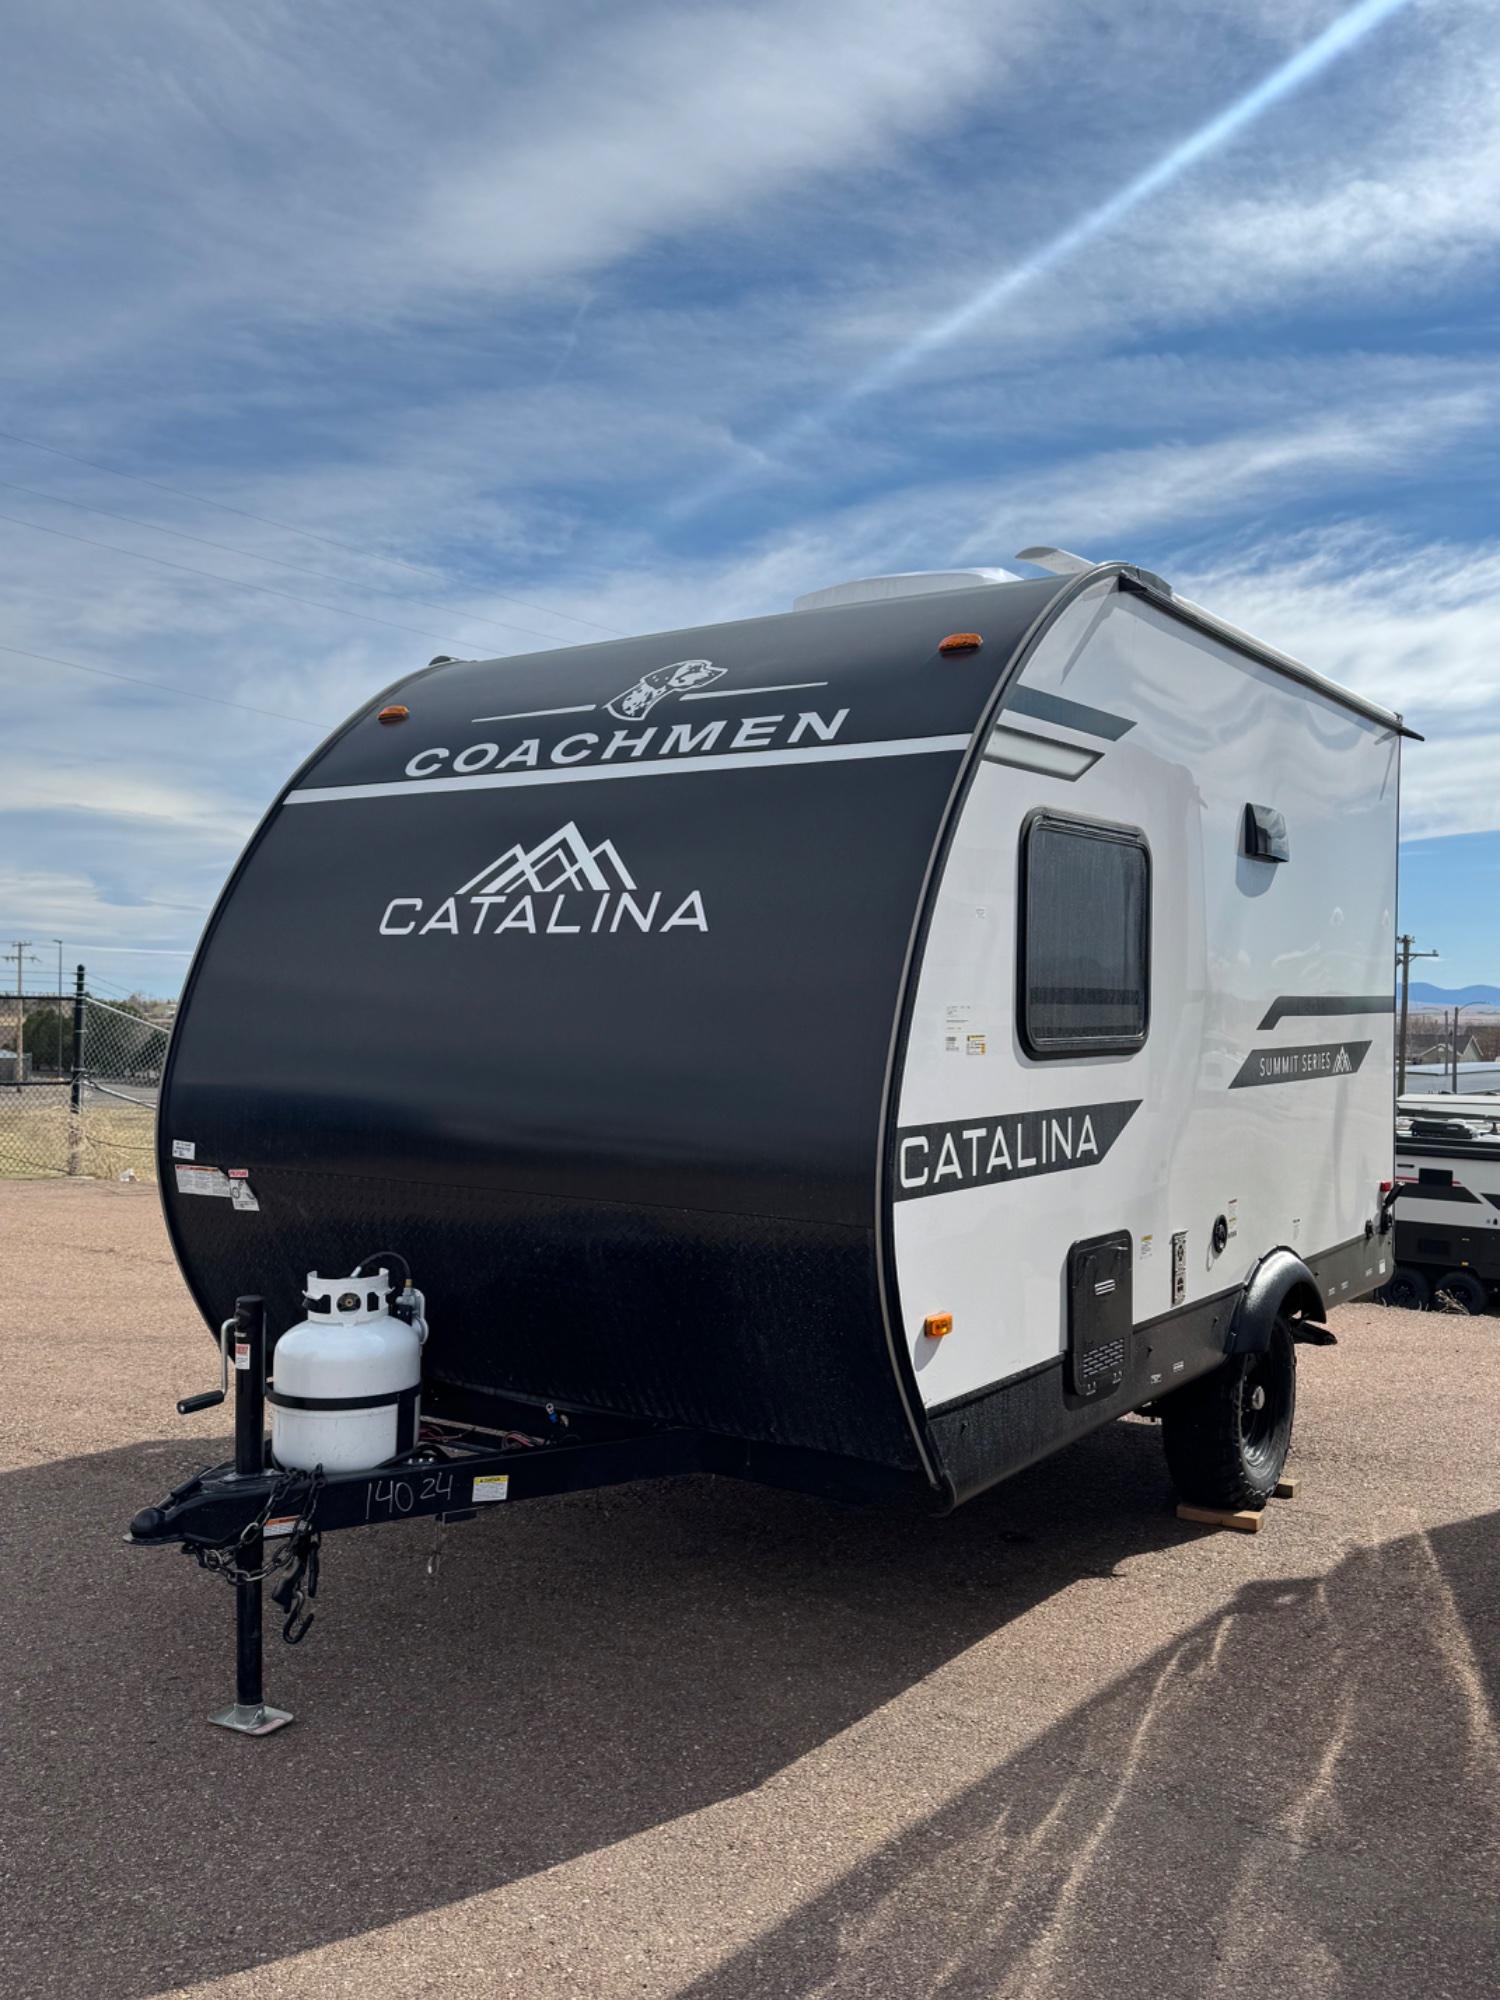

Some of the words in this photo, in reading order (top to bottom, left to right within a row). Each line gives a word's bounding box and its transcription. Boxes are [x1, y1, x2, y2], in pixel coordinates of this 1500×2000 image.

[405, 709, 850, 777] COACHMEN
[379, 891, 708, 934] CATALINA
[1259, 1055, 1299, 1077] SUMMIT
[1301, 1051, 1331, 1073] SERIES
[901, 1114, 1098, 1189] CATALINA
